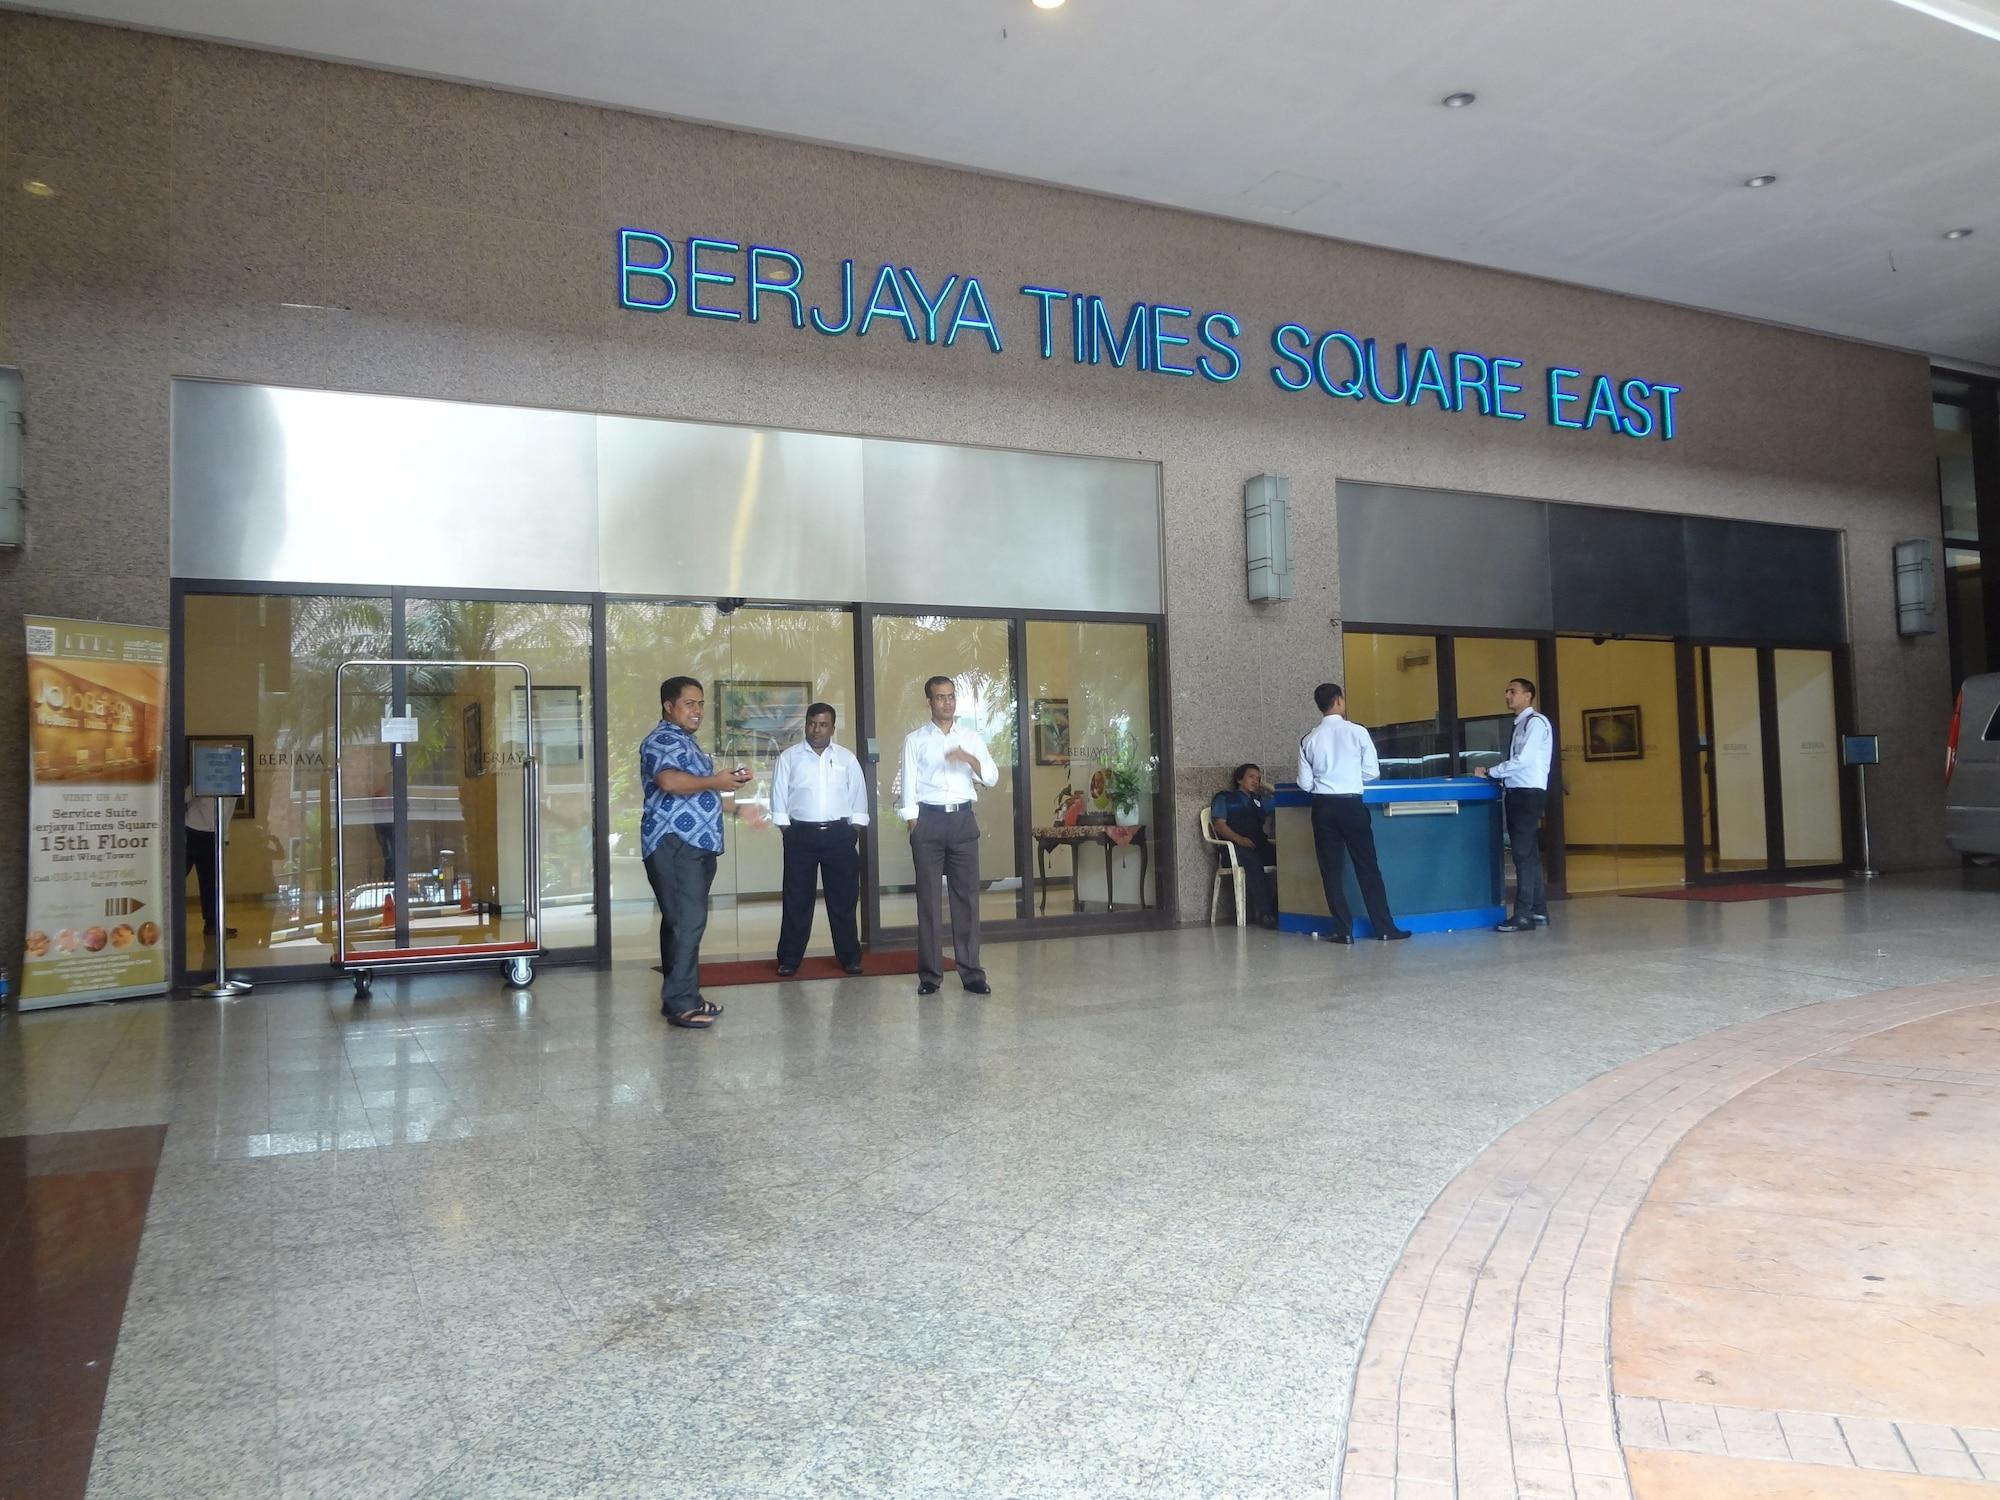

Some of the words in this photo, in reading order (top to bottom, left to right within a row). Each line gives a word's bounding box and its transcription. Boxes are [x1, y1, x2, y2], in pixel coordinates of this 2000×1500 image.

[617, 227, 1003, 354] BERJAYA
[1020, 285, 1241, 384] TIMES
[1271, 323, 1526, 420] SQUARE
[1546, 367, 1682, 441] EAST
[259, 752, 325, 766] BERJAYA
[52, 807, 102, 819] Service
[105, 807, 138, 818] Suite
[76, 821, 114, 832] Times
[117, 820, 160, 833] Square
[40, 834, 90, 852] 15th
[97, 833, 149, 850] Floor
[52, 854, 75, 863] East
[79, 852, 103, 863] Wing
[106, 851, 136, 860] Tower
